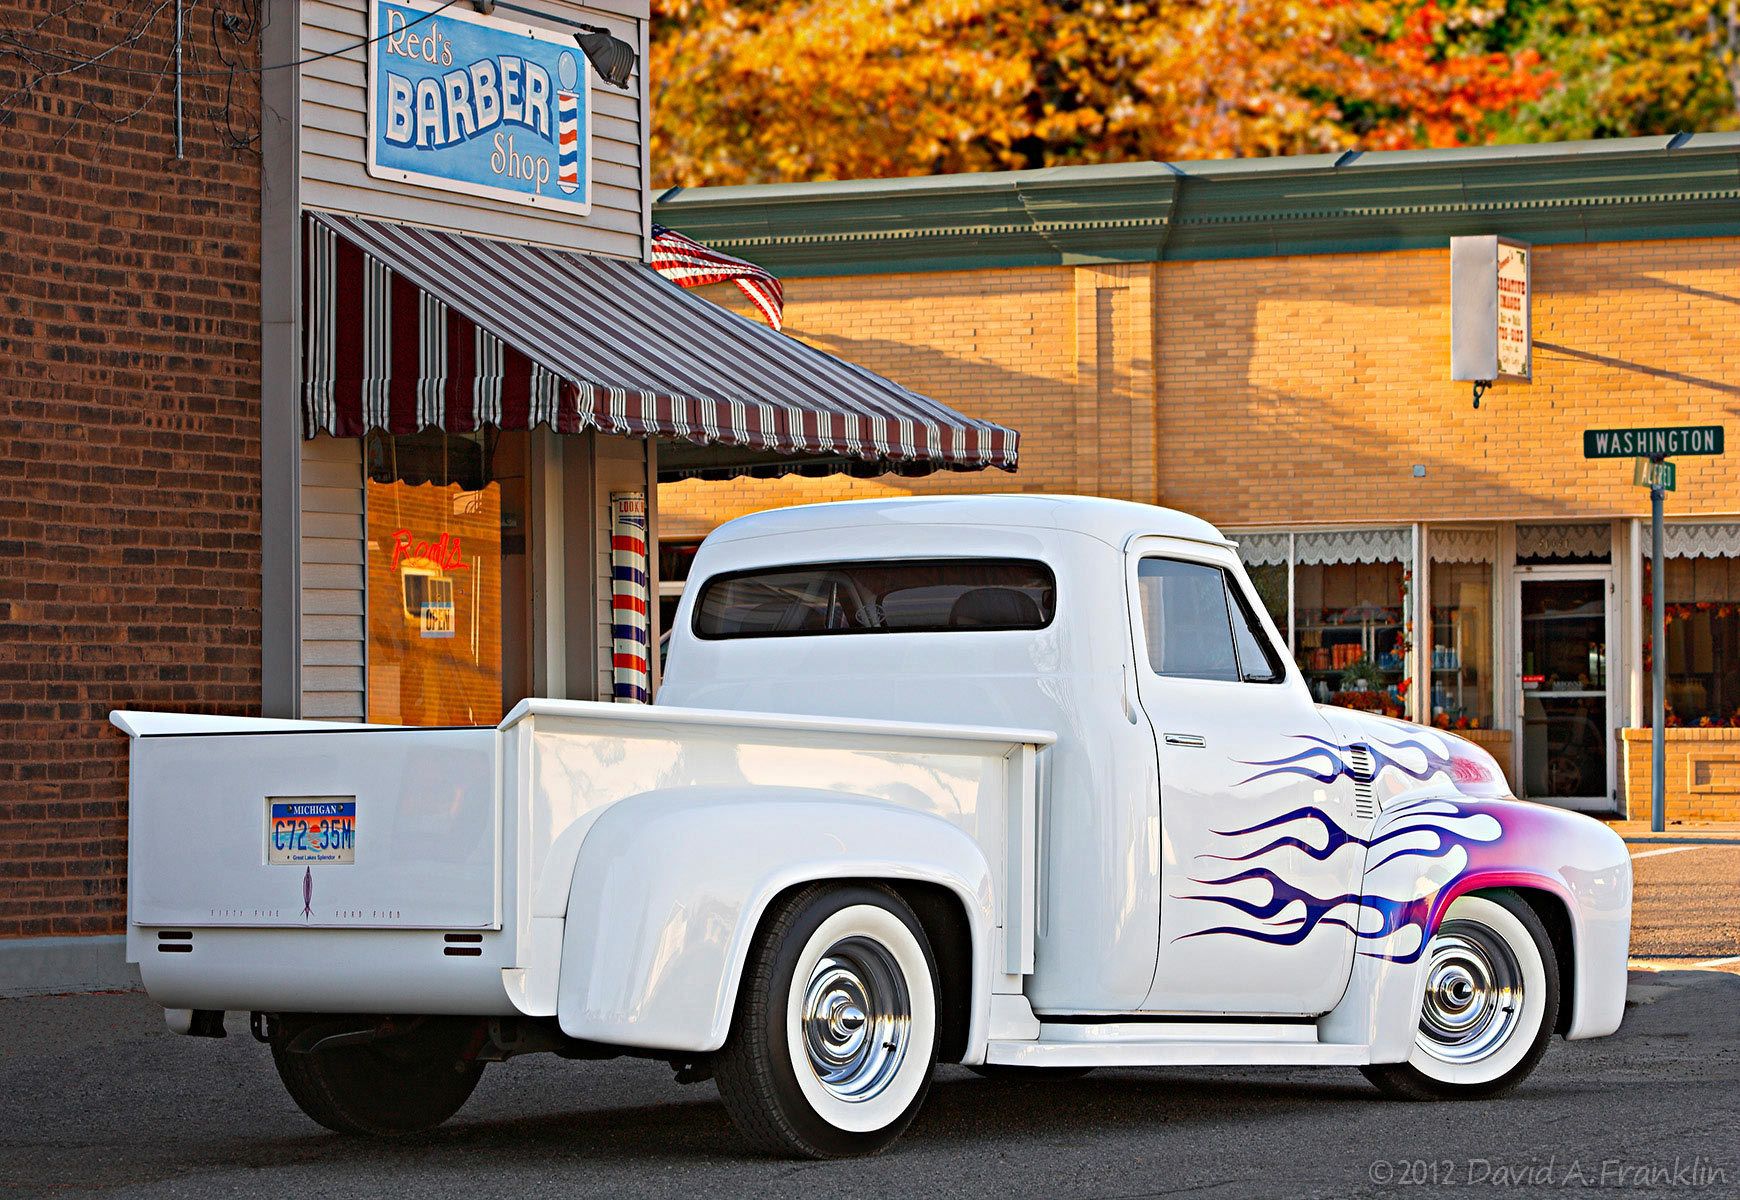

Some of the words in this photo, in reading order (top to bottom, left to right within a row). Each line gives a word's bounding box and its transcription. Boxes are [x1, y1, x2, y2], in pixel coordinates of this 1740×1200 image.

[386, 8, 454, 67] Red's
[384, 55, 553, 150] BARBER
[491, 132, 551, 194] Shop
[1596, 429, 1715, 454] WASHINGTON
[619, 501, 640, 513] LOOK
[426, 608, 450, 631] OPEN
[293, 805, 337, 815] MICHIGAN
[275, 820, 307, 850] C72
[320, 819, 352, 850] 35M
